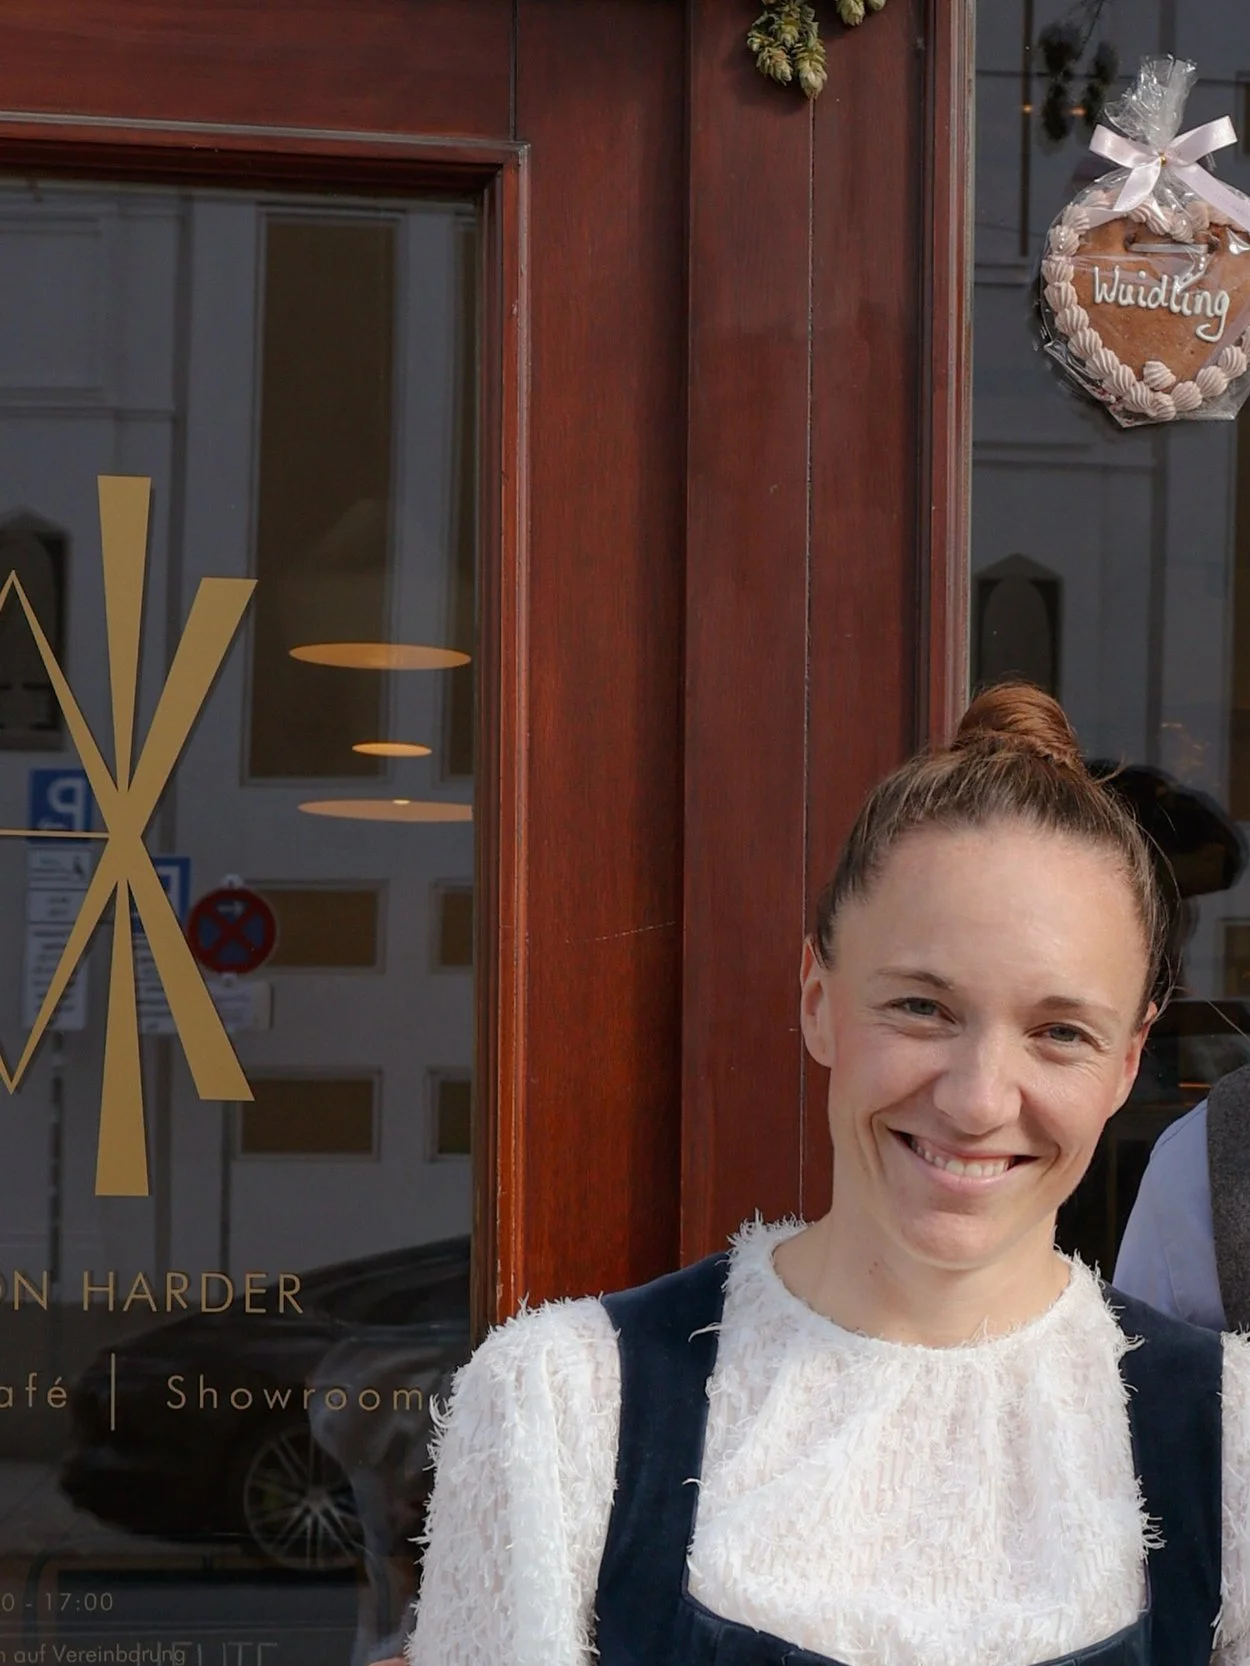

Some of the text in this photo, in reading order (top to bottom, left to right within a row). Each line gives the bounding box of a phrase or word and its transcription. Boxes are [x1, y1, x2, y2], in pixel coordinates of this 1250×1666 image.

[0, 1270, 303, 1314] N HARDER
[166, 1374, 424, 1411] Showroom
[45, 1592, 114, 1612] 17:00
[14, 1644, 46, 1663] auf
[52, 1643, 187, 1666] Vereinbarung
